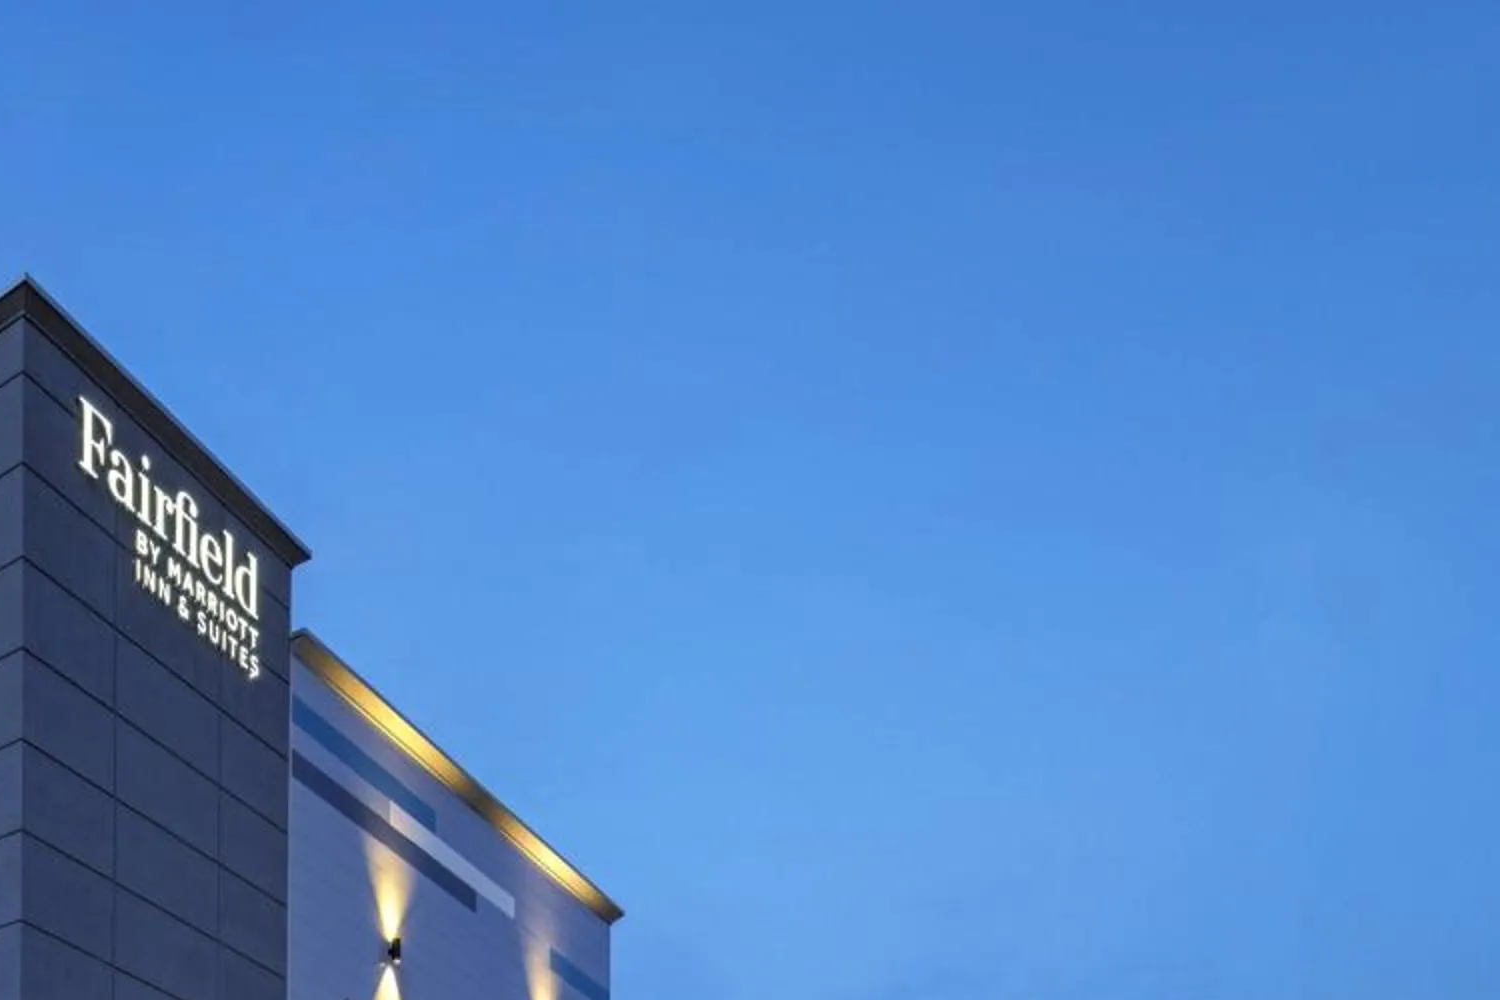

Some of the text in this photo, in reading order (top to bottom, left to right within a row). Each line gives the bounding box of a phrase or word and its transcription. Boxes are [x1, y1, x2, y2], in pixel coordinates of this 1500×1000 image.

[78, 396, 259, 620] Fairfield
[135, 559, 260, 680] INN & SUITES
[136, 529, 259, 648] BY MARRIOTT
